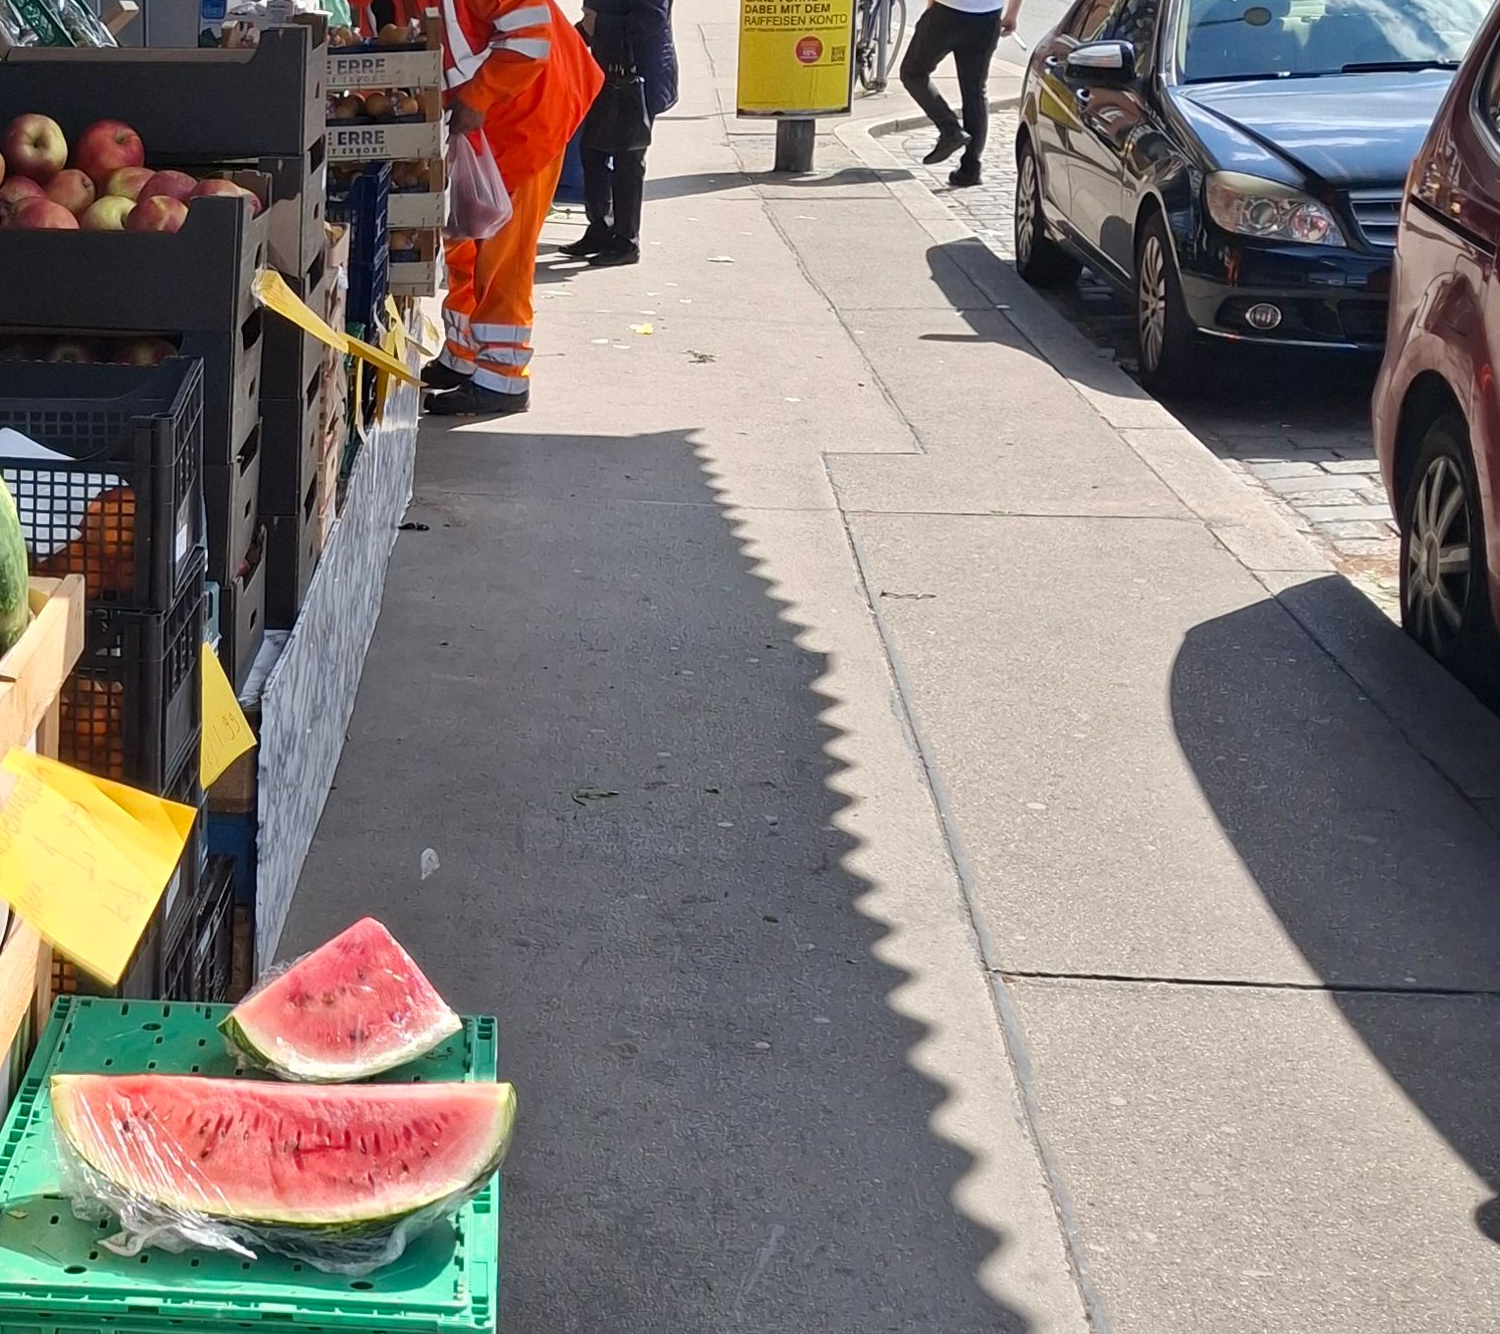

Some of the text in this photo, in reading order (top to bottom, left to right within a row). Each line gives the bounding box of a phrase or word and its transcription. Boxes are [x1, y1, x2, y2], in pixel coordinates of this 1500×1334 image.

[745, 3, 831, 14] DABEI MIT DEM
[744, 13, 848, 26] RAIFFEISEN KONTO
[337, 130, 385, 146] ERRE
